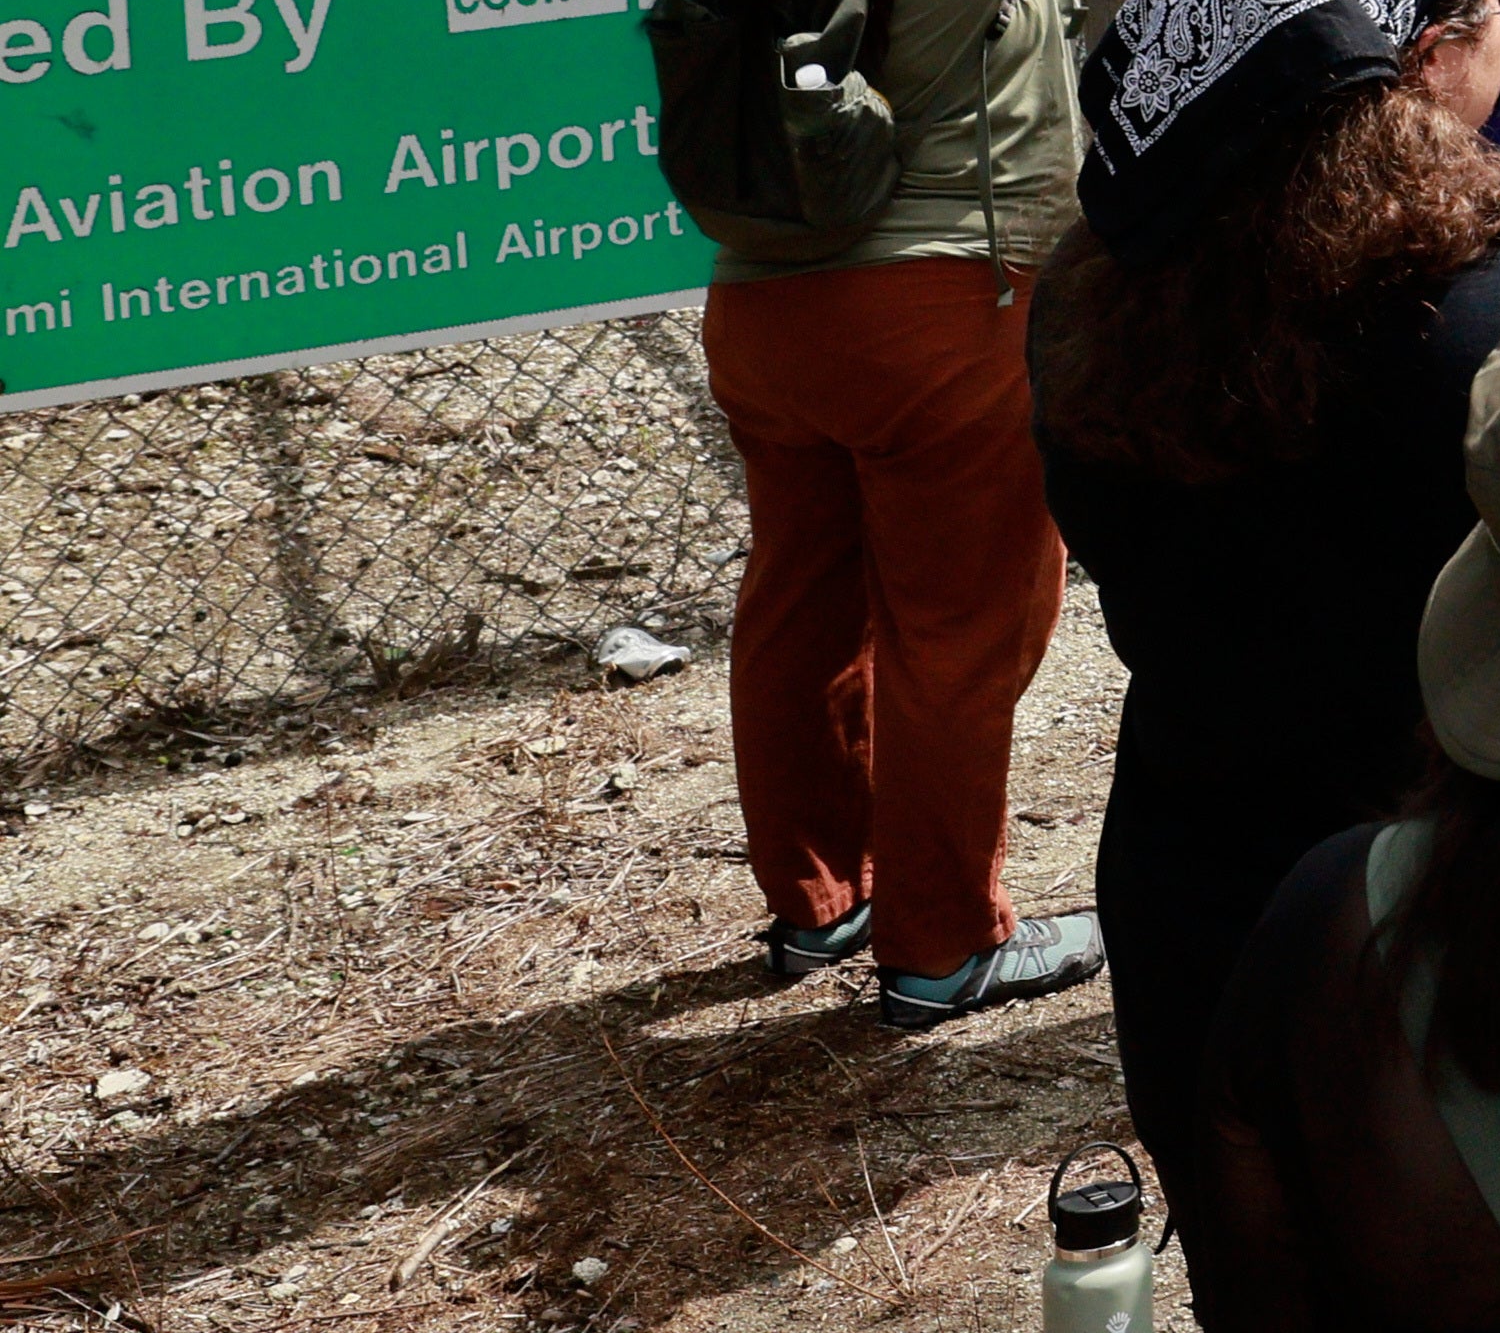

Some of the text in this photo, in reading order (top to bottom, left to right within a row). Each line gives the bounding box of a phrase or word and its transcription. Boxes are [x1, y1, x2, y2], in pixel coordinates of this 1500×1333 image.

[4, 105, 660, 248] Aviation Airport
[101, 231, 469, 322] International
[495, 200, 685, 265] Airport
